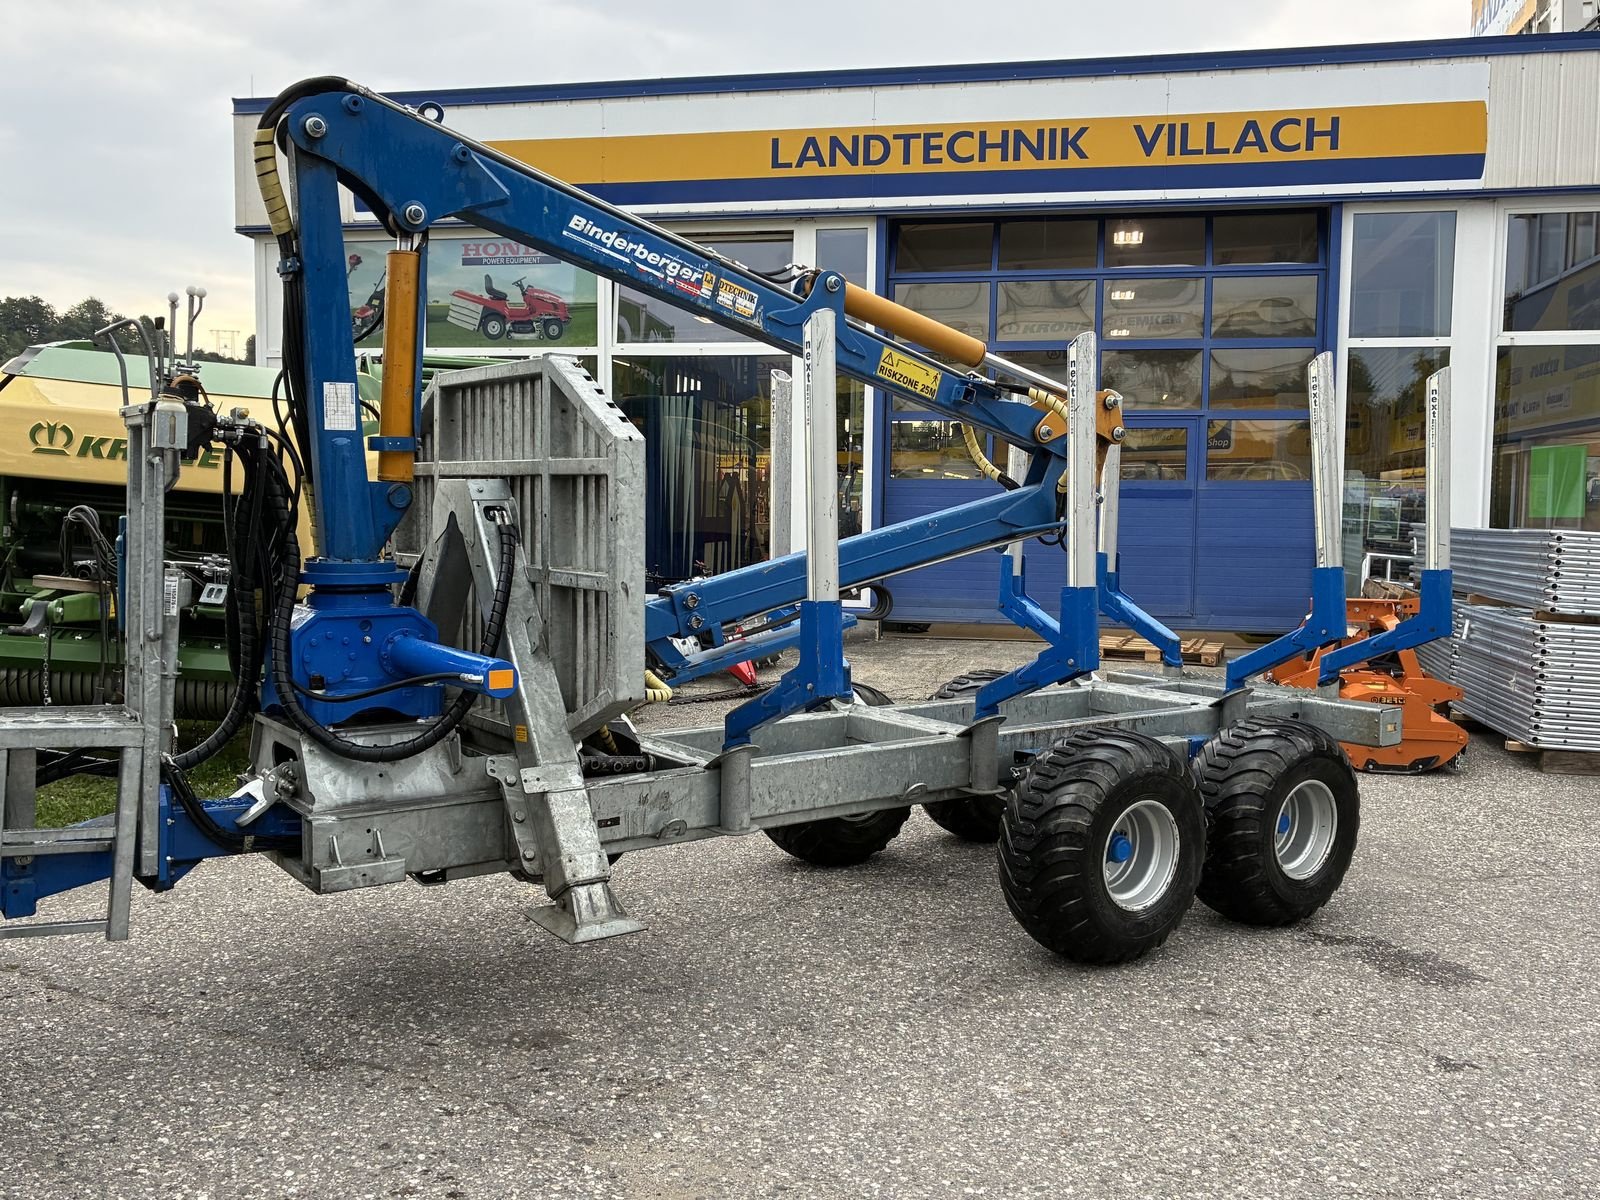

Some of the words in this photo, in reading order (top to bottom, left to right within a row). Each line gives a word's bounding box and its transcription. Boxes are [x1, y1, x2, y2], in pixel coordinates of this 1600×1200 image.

[771, 126, 1090, 169] LANDTECHNIK
[1133, 116, 1340, 158] VILLACH
[482, 257, 504, 265] POWER
[568, 214, 703, 282] Binderberger
[703, 272, 758, 305] LADTECHNIK
[878, 365, 919, 390] RISKZONE
[919, 383, 936, 398] 25M
